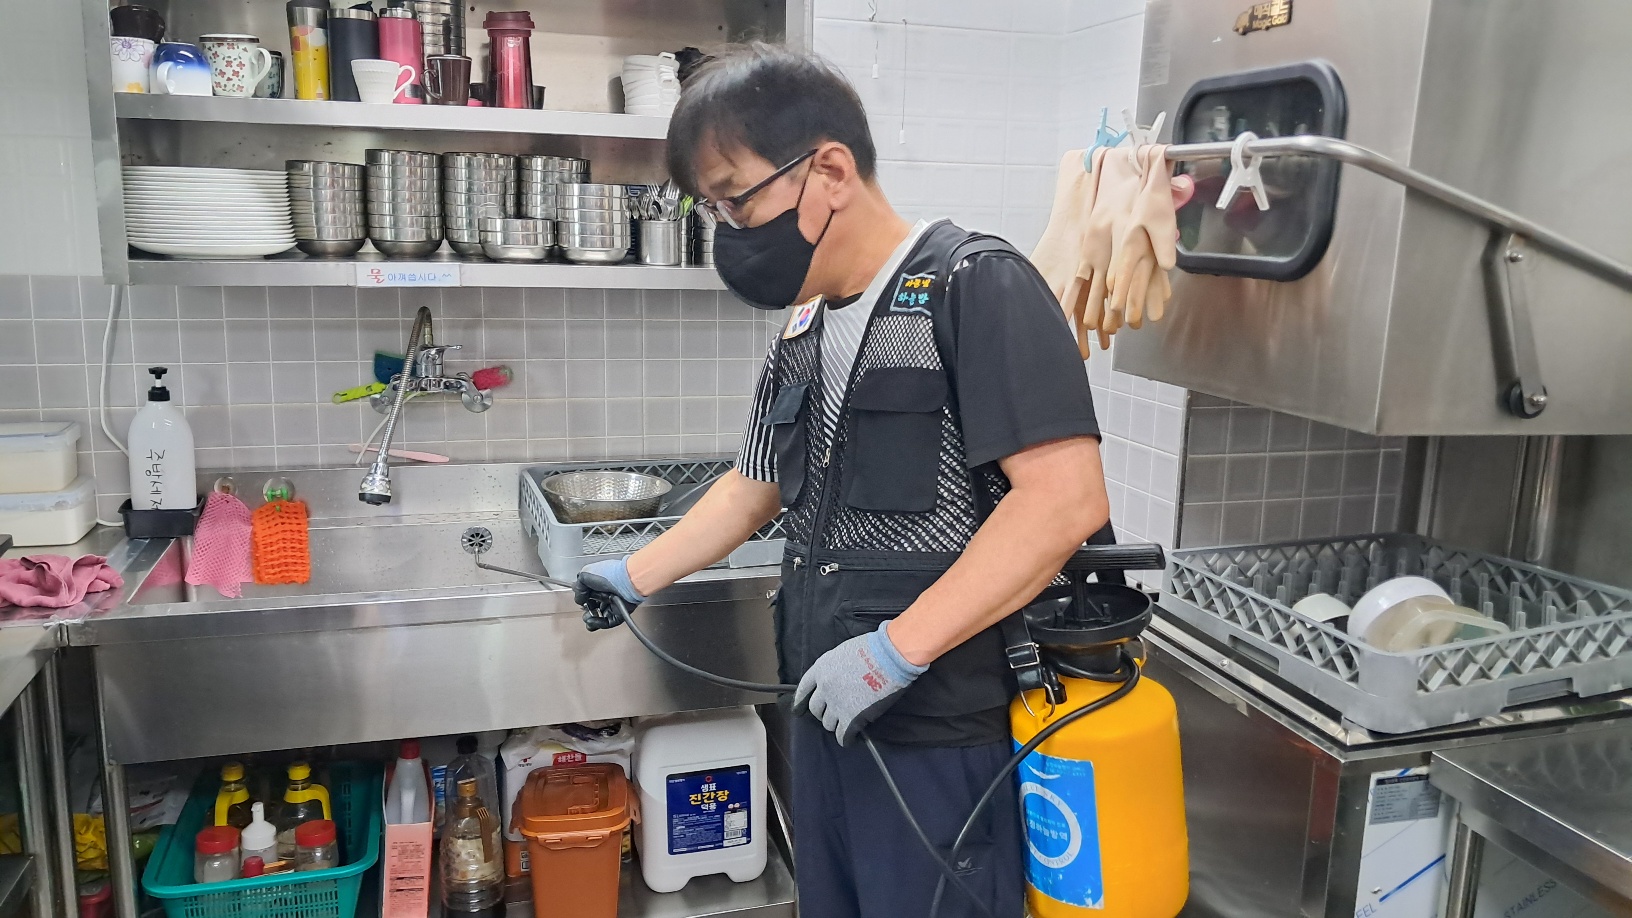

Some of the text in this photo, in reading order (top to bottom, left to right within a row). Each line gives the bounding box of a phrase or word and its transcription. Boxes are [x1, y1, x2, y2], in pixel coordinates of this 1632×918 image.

[366, 268, 385, 284] 물
[862, 672, 883, 692] 3M
[700, 782, 717, 793] 샘표
[689, 789, 730, 805] 진간장
